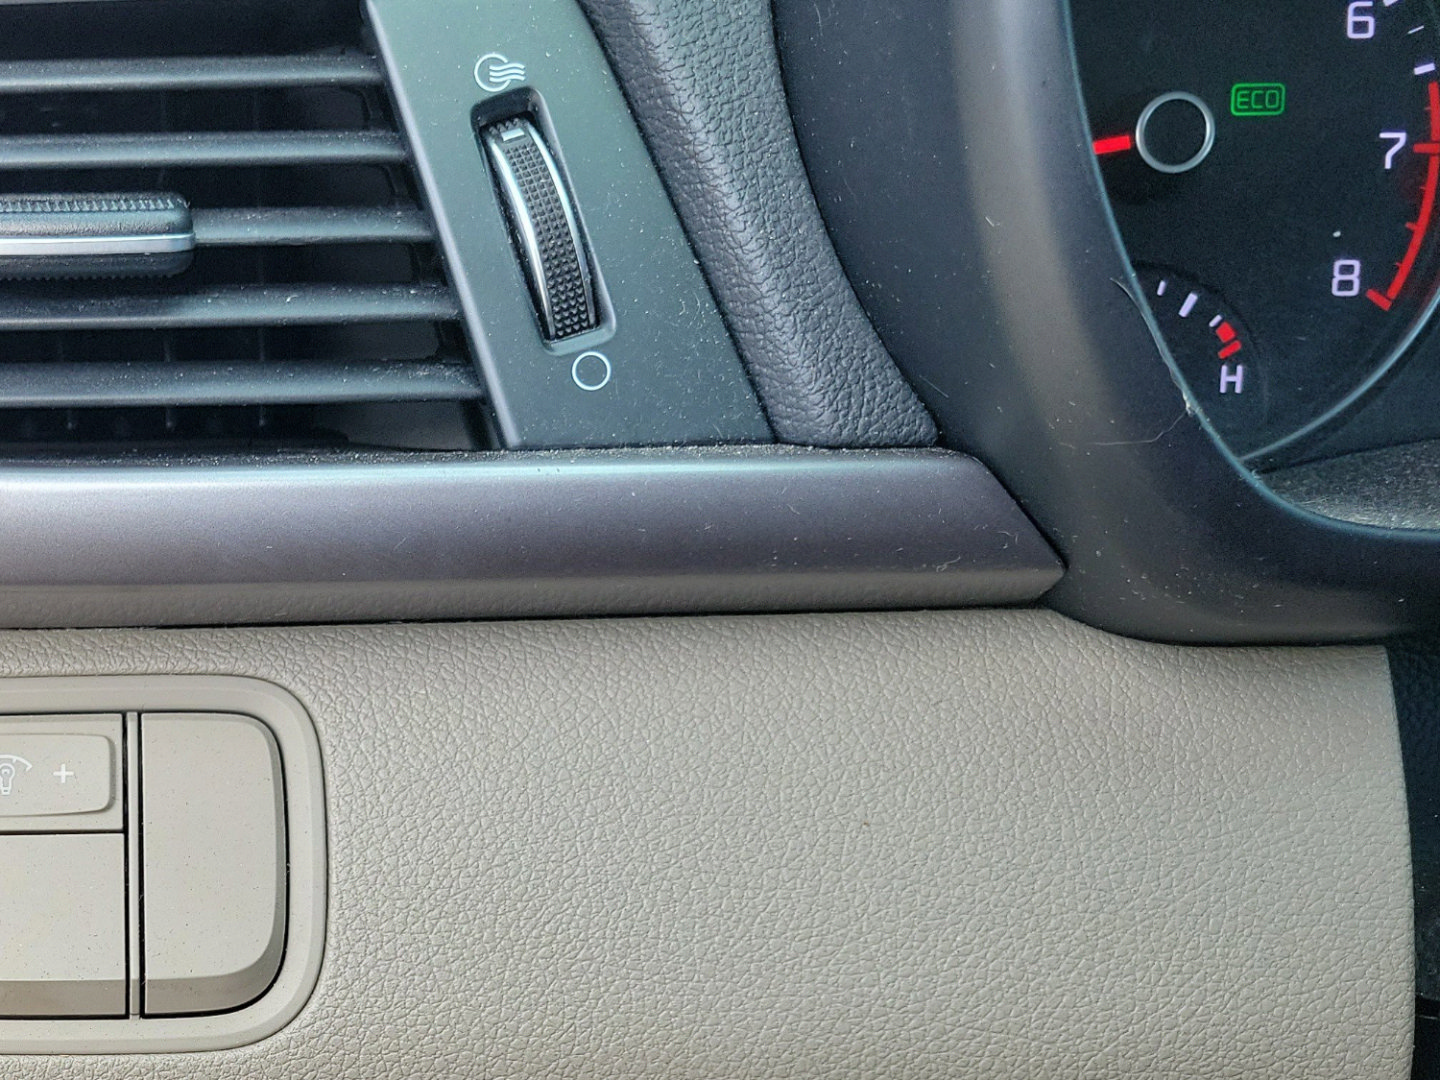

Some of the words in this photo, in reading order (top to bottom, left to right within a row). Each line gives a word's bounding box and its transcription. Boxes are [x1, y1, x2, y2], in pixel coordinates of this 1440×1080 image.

[1346, 1, 1375, 39] 6
[1236, 90, 1280, 109] ECO
[1379, 131, 1407, 170] 7
[1331, 259, 1361, 297] 8
[1219, 364, 1244, 394] H
